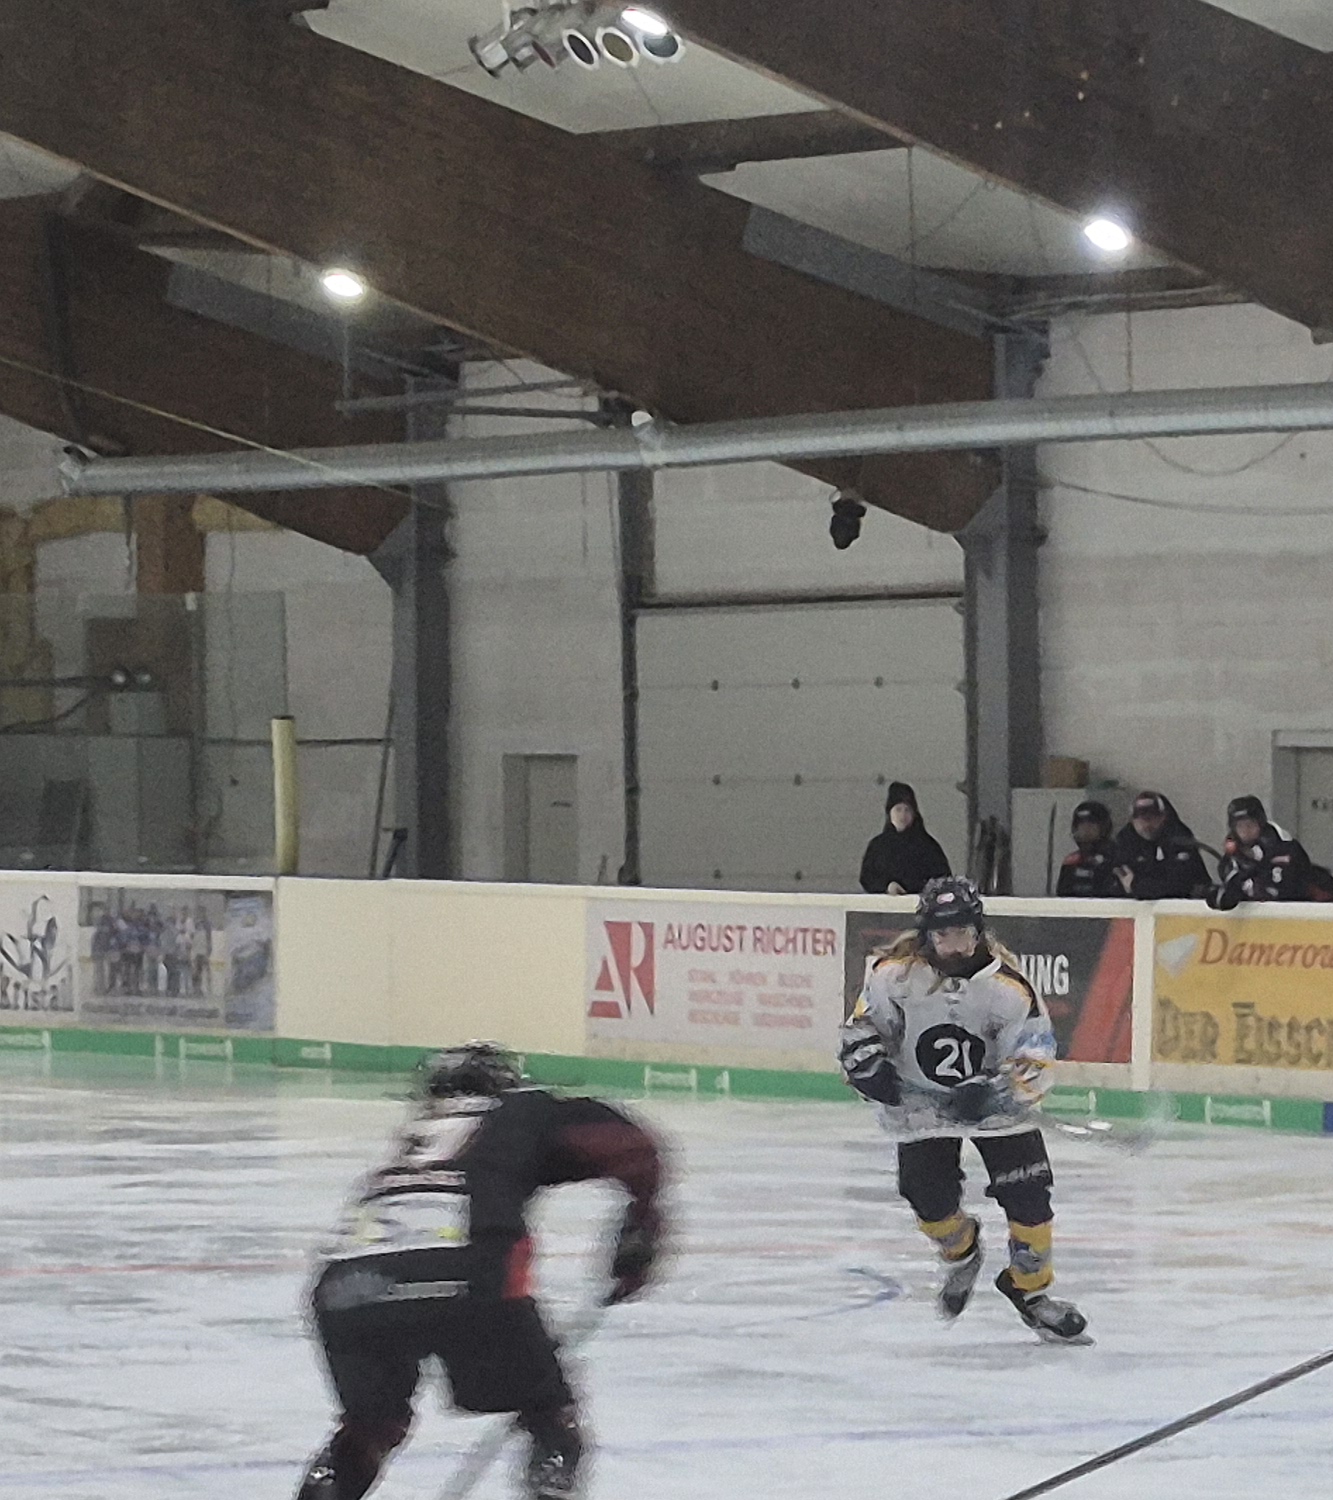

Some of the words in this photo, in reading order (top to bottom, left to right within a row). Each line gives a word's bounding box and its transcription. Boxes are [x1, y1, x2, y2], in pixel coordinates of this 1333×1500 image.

[663, 922, 747, 953] AUGUST
[752, 926, 837, 956] RICHTER
[933, 1037, 973, 1080] 21
